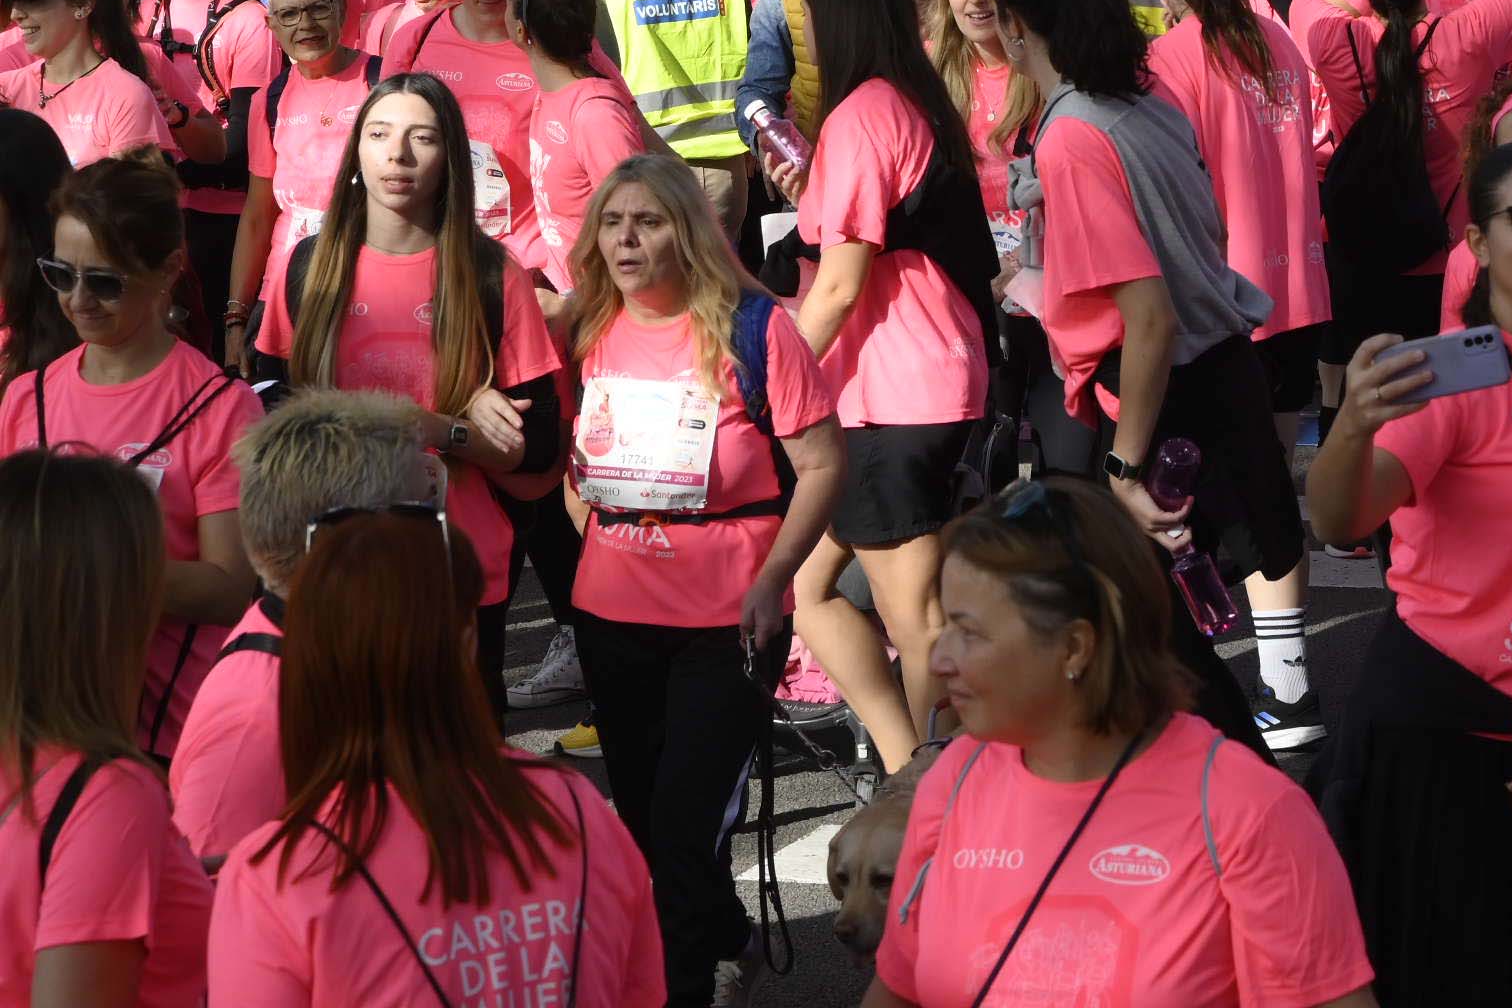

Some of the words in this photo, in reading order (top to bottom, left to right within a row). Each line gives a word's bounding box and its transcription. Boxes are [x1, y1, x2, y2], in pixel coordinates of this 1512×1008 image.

[587, 467, 620, 478] CARRERA
[621, 470, 632, 479] DE
[633, 471, 643, 480] LA
[651, 489, 696, 500] Santander
[953, 848, 1025, 870] OYSHO
[1096, 857, 1164, 877] ASTURIANA
[418, 898, 590, 967] CARRERA
[460, 952, 511, 998] DE
[519, 942, 571, 982] LA
